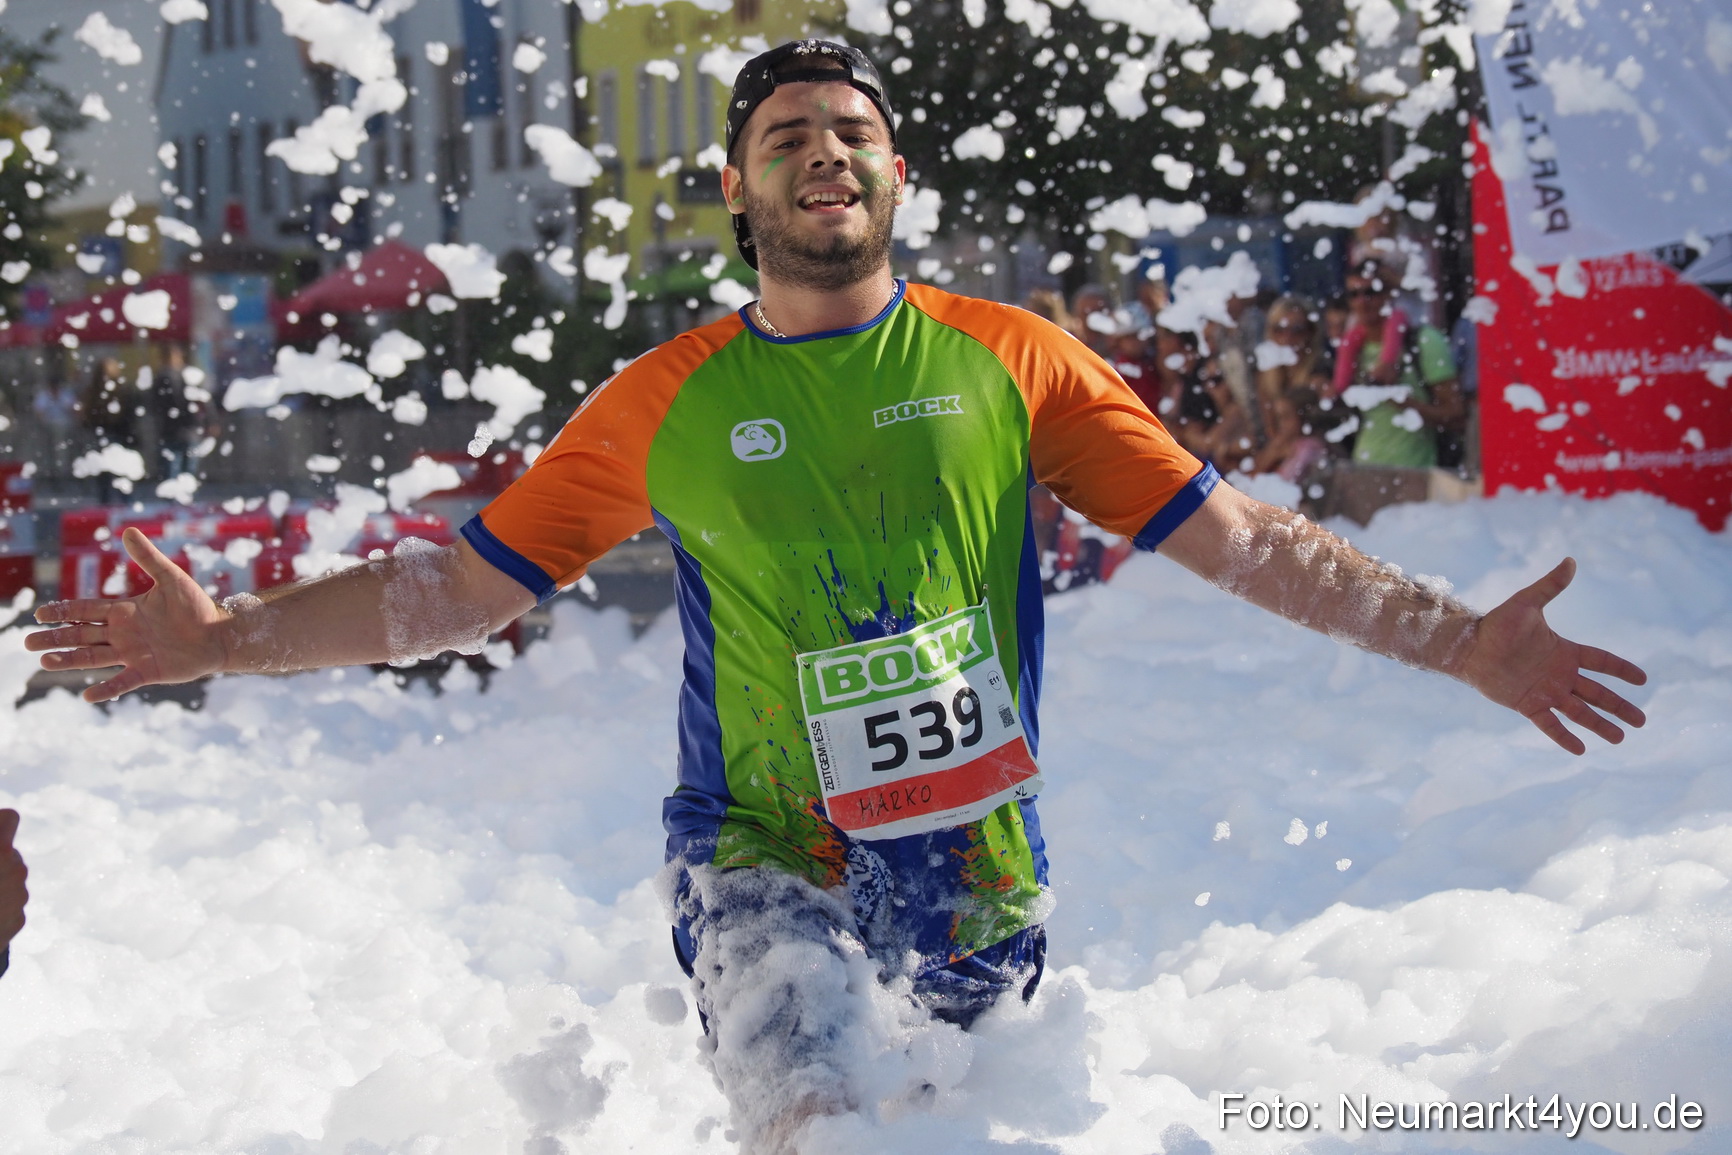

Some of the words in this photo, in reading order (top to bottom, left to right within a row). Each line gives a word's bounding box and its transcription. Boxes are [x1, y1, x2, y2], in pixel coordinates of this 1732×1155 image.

[873, 395, 965, 428] BOCK
[814, 615, 983, 705] BOCK
[864, 687, 983, 772] 539
[860, 785, 932, 820] MARKO
[1014, 785, 1027, 798] XL
